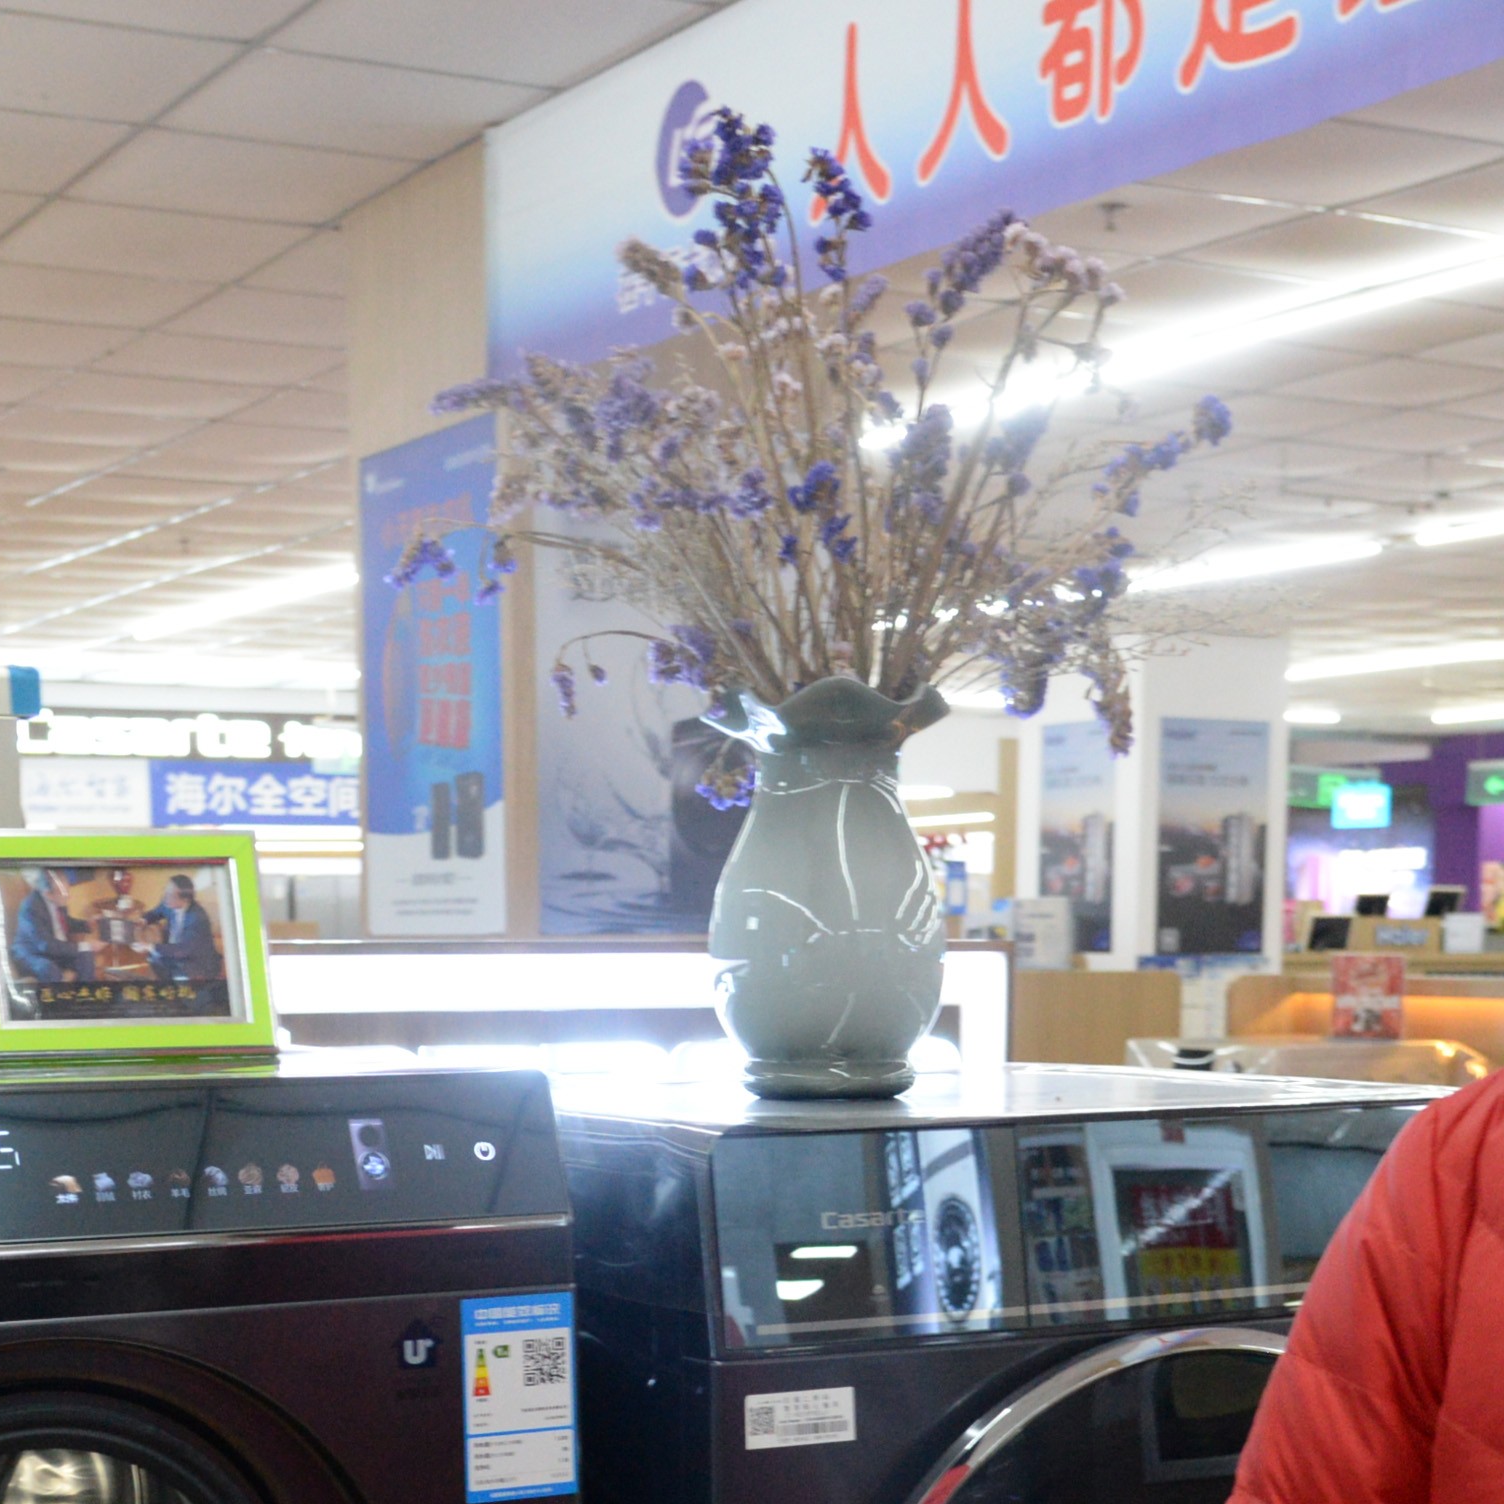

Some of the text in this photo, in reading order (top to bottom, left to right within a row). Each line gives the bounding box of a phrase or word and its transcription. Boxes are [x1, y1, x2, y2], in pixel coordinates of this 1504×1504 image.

[165, 772, 360, 818] 海尔全空间
[821, 1207, 926, 1231] Casarte
